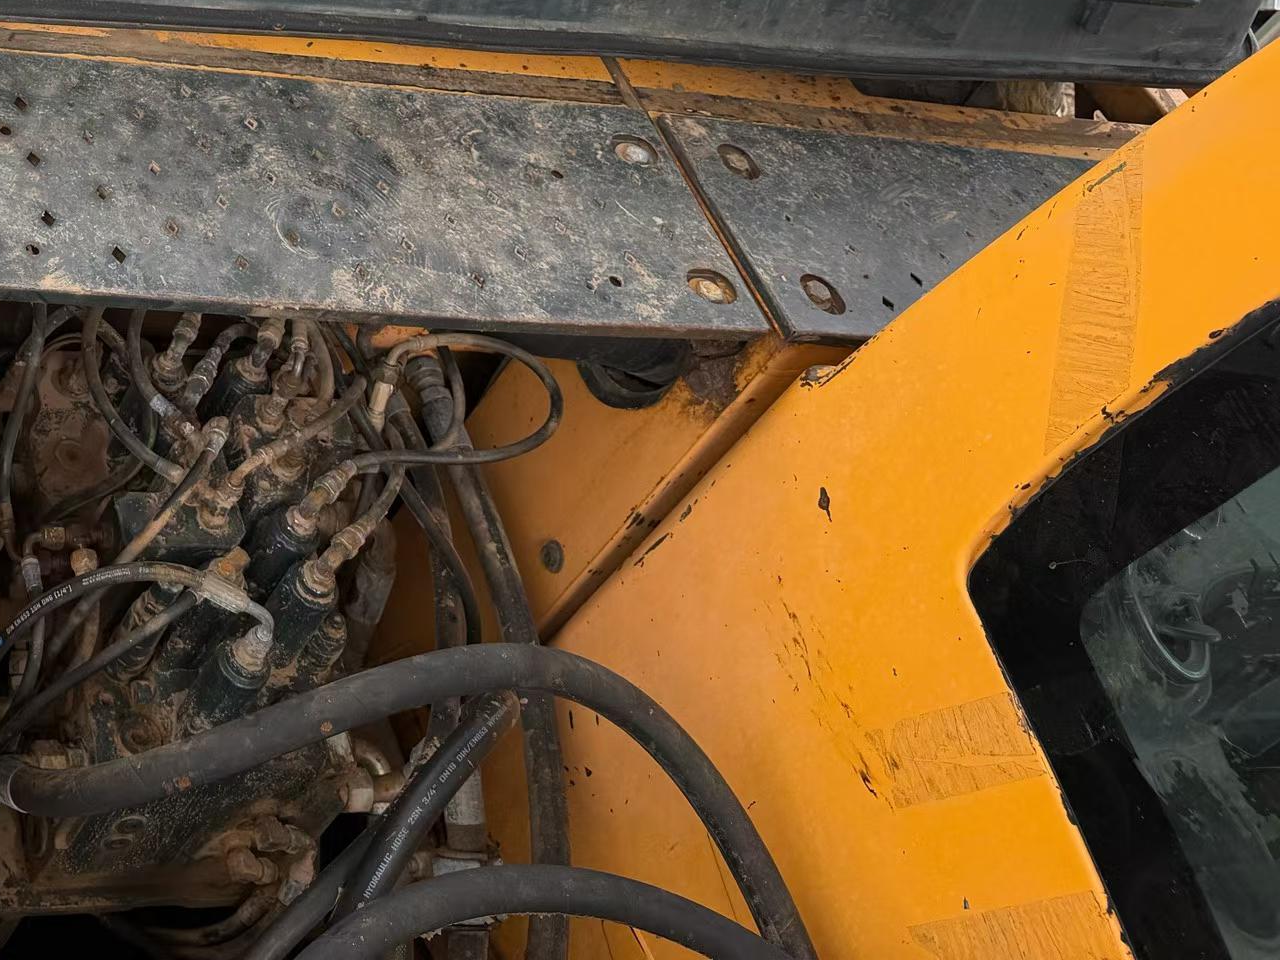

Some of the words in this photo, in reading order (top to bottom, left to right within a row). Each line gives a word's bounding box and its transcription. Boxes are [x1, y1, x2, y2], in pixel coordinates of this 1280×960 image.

[363, 852, 394, 899] HYDRAULIC
[392, 826, 409, 853] HOSE
[407, 806, 424, 826] 2SN
